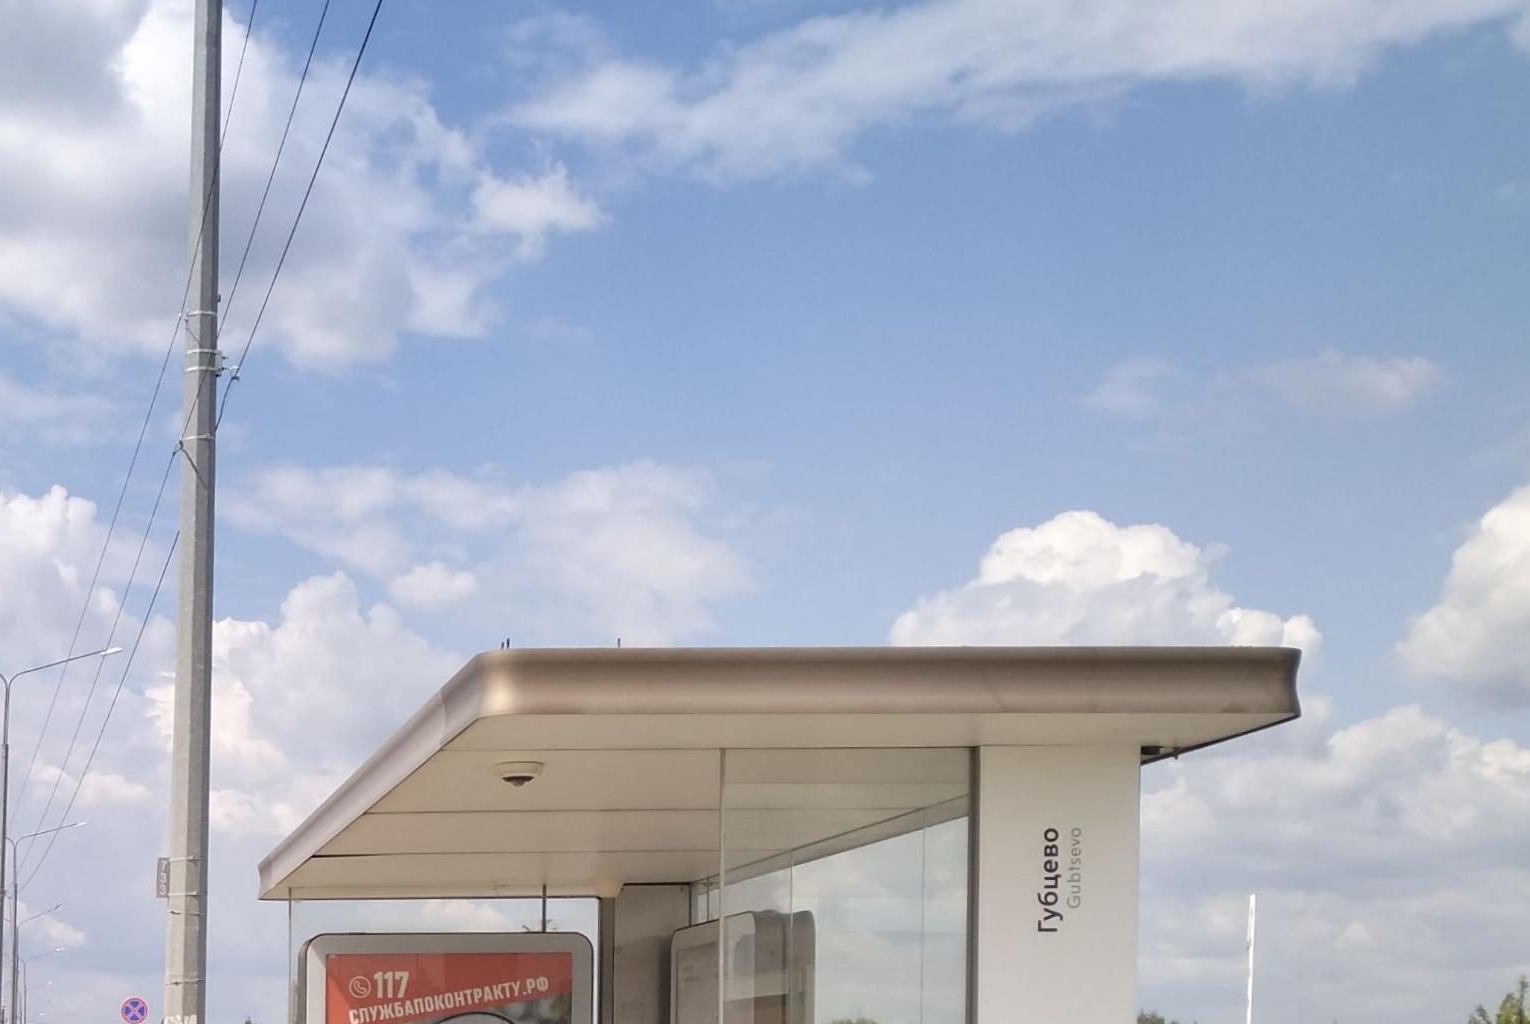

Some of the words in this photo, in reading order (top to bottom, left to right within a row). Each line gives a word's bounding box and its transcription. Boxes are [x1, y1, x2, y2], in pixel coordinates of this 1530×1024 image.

[1037, 828, 1063, 932] Губцево
[1067, 827, 1082, 909] Gubtsevo
[373, 970, 409, 999] 117
